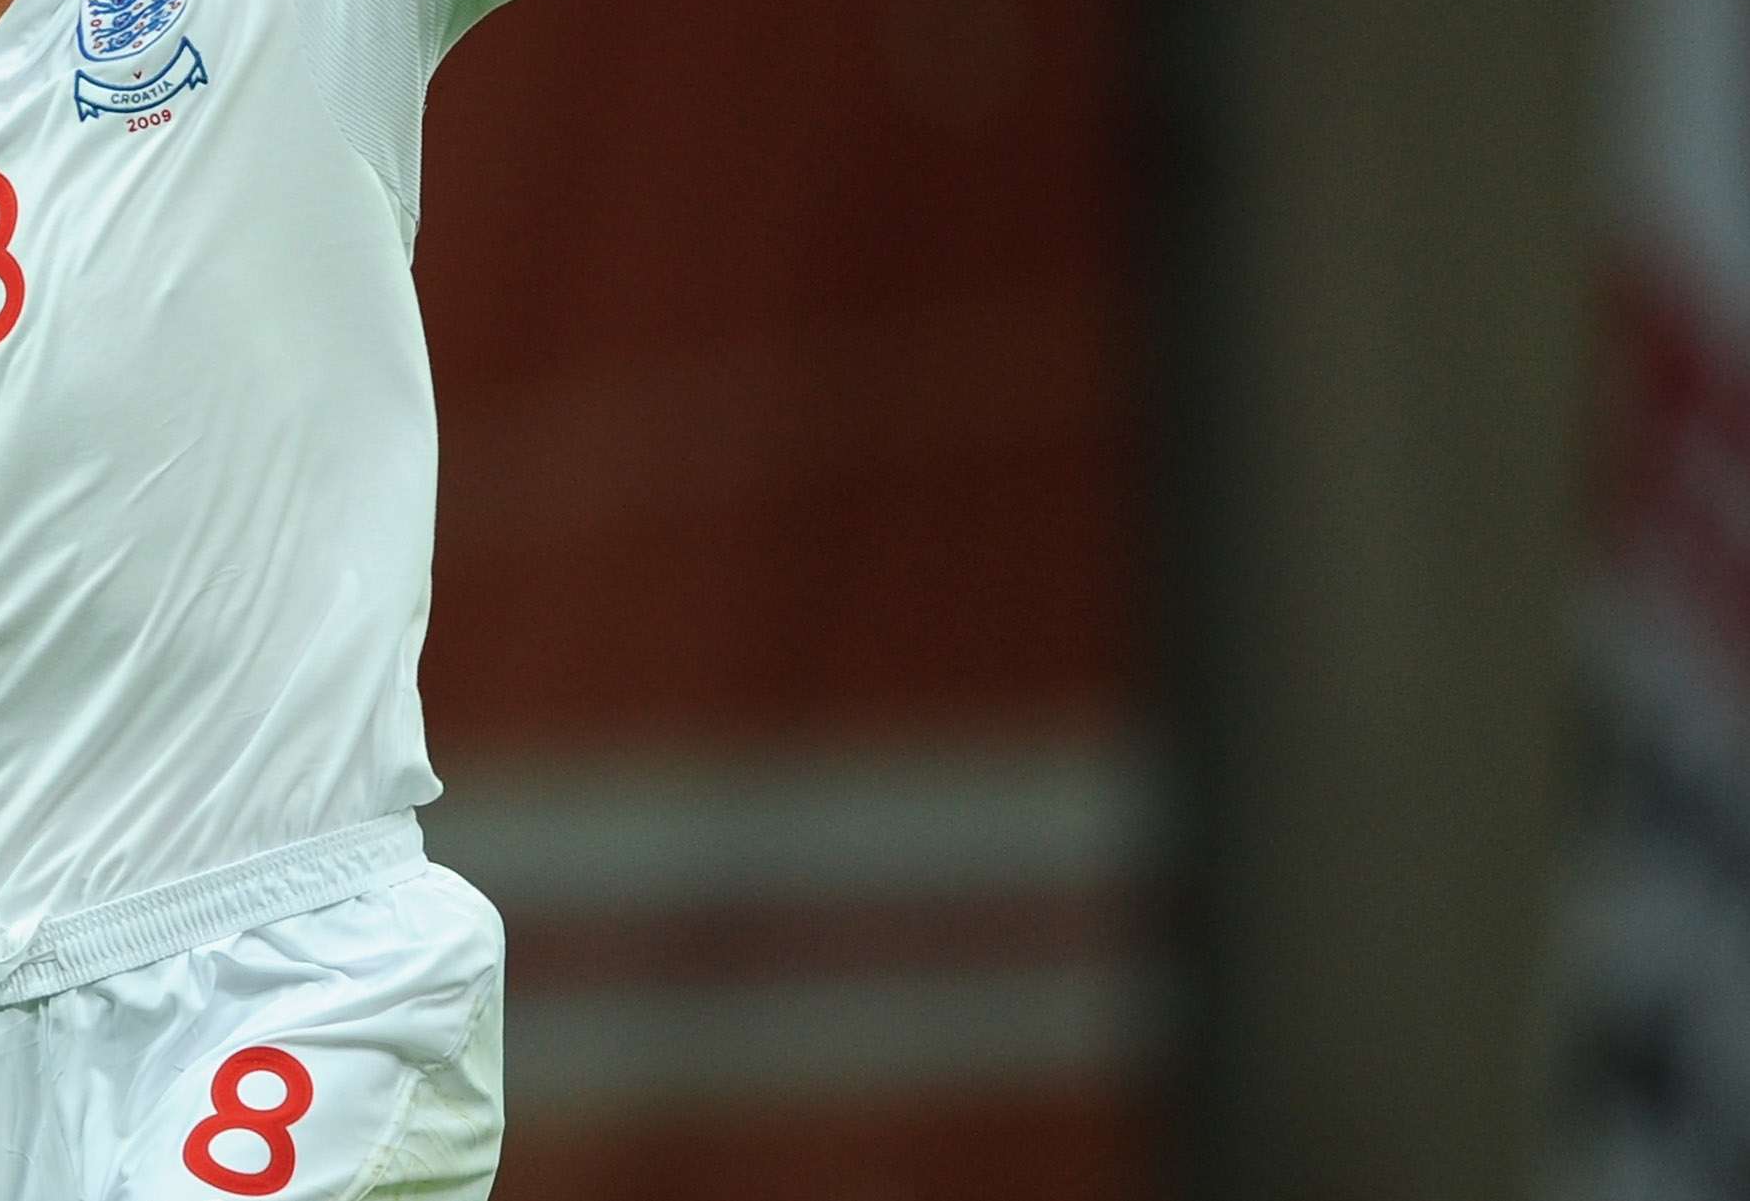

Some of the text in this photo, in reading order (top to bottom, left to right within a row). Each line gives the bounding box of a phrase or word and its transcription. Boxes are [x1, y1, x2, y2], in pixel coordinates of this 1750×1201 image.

[111, 81, 173, 104] CROATIA
[127, 109, 172, 132] 2009
[182, 1046, 313, 1197] 8
